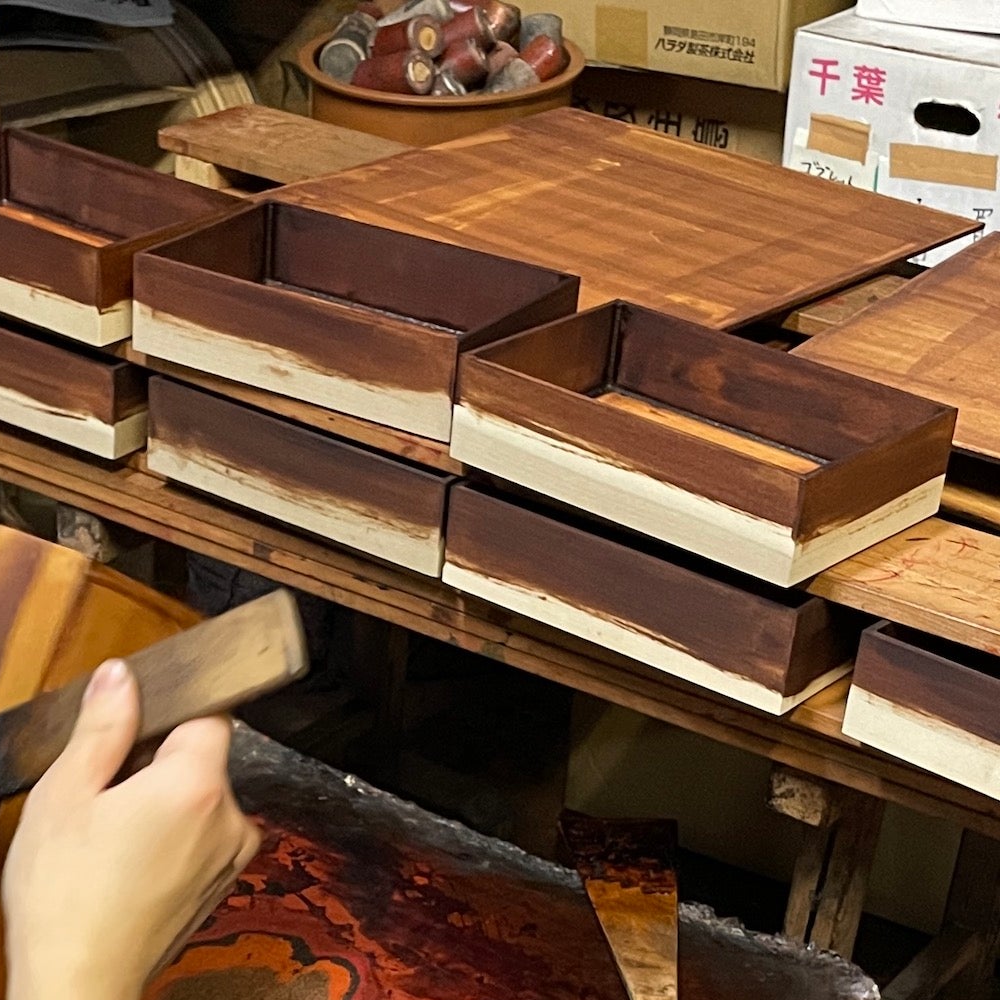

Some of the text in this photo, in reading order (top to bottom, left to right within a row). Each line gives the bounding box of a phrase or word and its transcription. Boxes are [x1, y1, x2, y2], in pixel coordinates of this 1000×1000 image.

[654, 37, 755, 64] ハラダ製茶株式会社
[808, 58, 887, 106] 千葉
